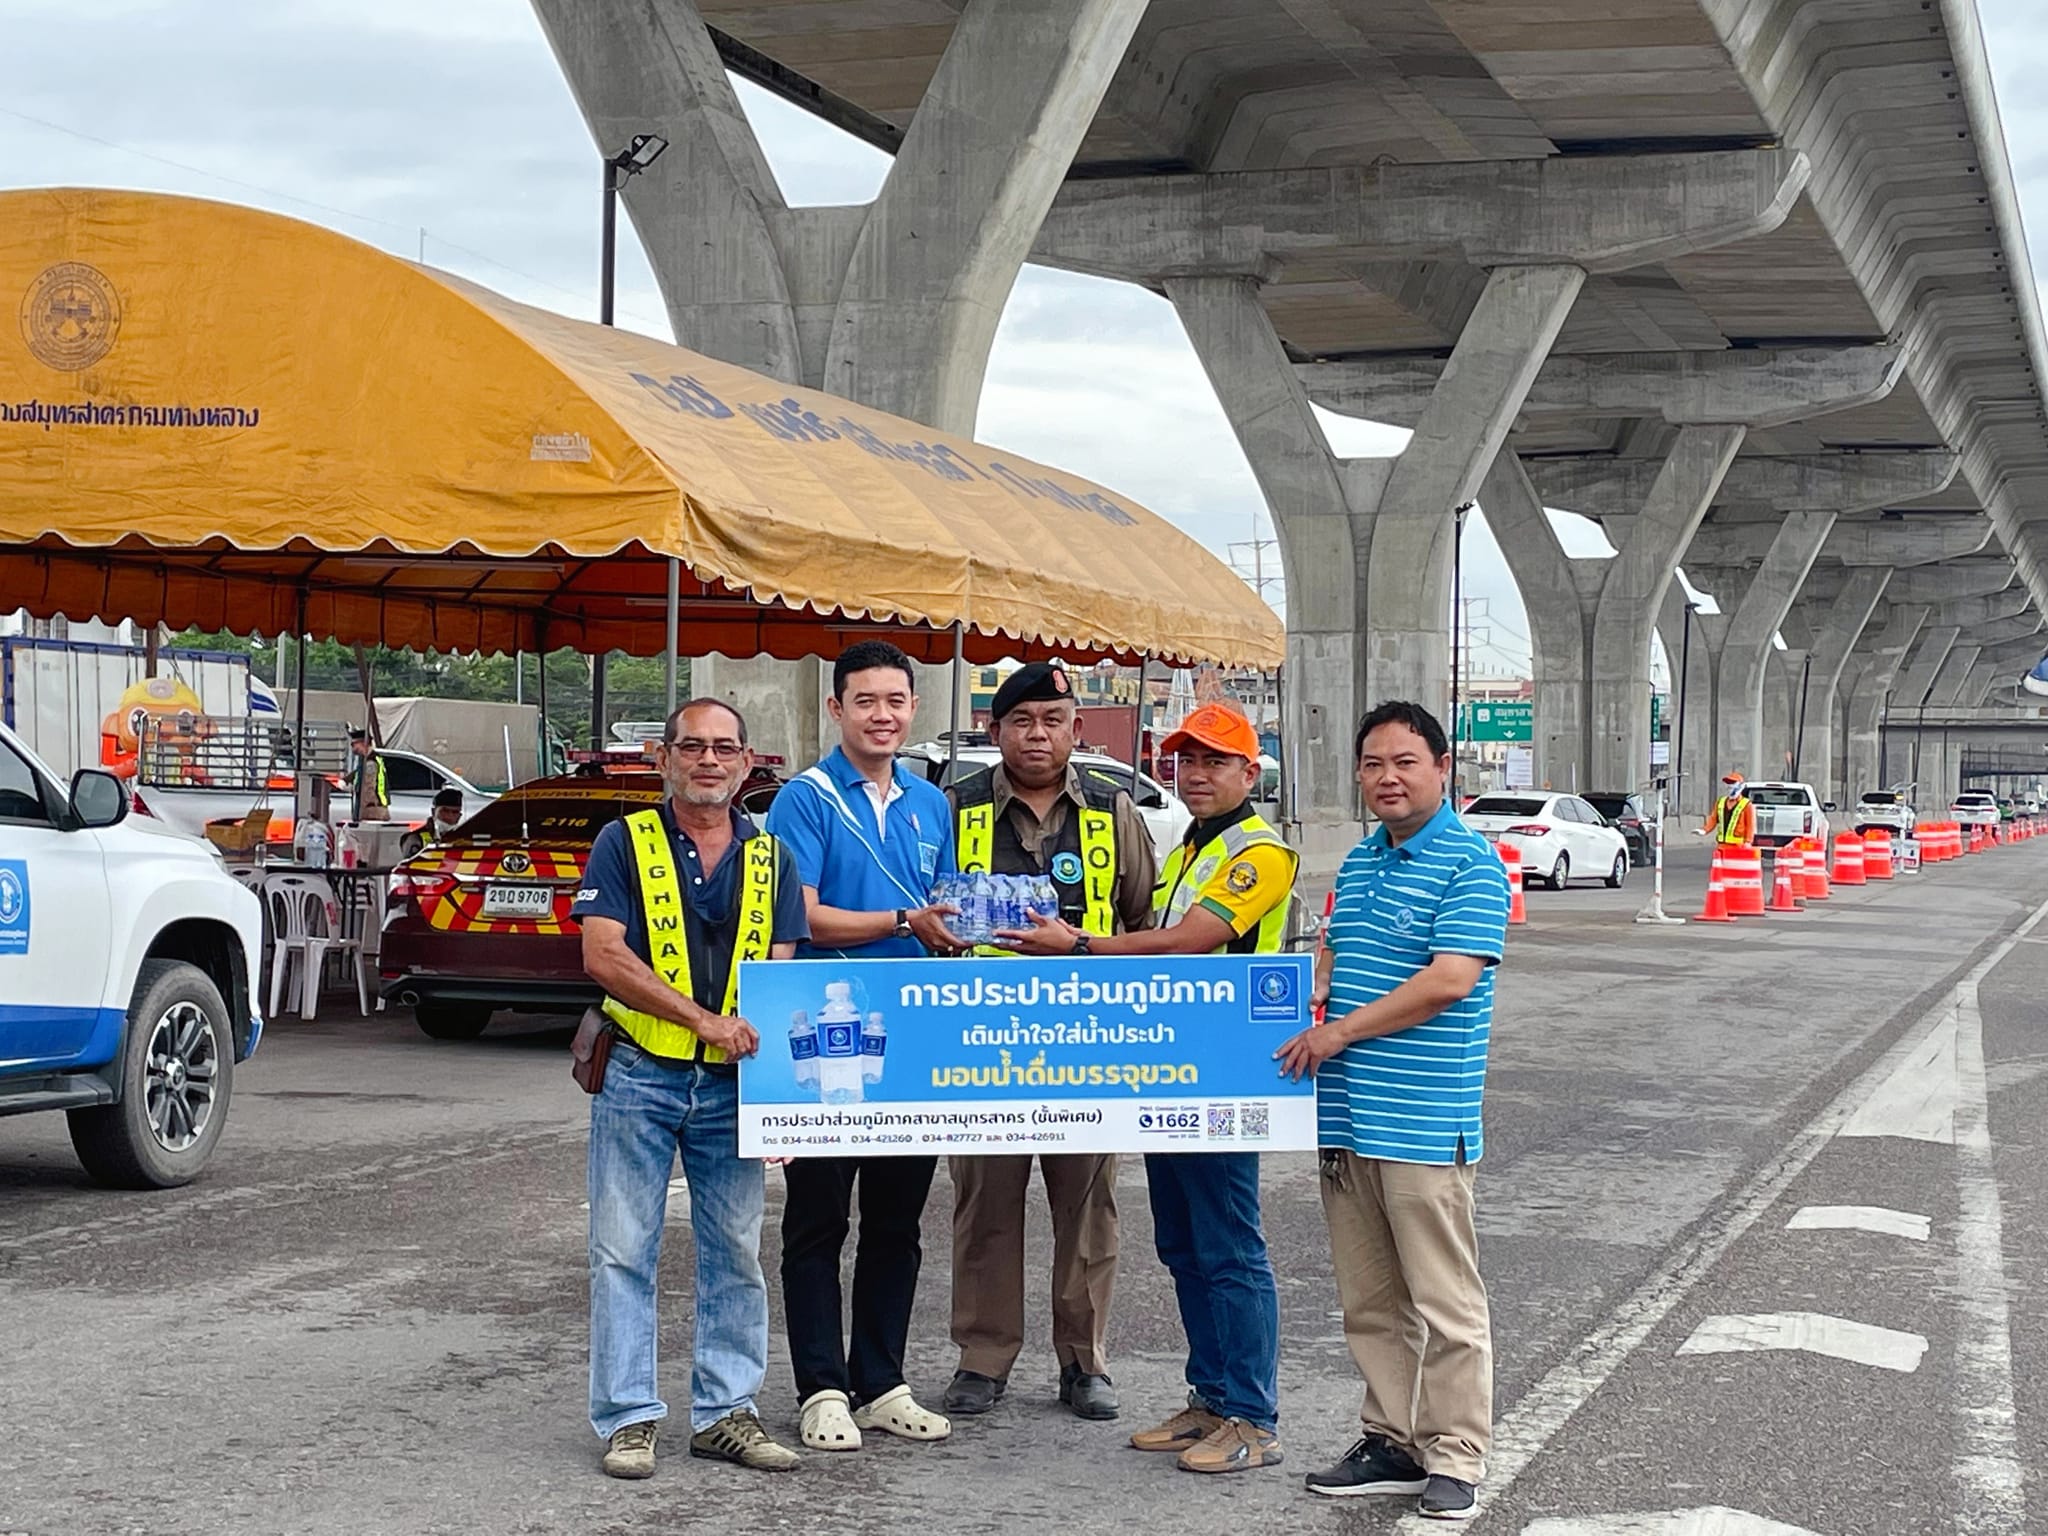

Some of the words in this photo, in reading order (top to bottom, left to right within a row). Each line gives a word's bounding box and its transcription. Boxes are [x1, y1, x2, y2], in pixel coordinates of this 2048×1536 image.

[540, 817, 590, 828] 2116
[517, 889, 549, 905] 9706
[638, 823, 679, 984] HIGHWAY
[899, 972, 1236, 1015] การประปาส่วนภูมิภาค
[961, 1015, 1176, 1046] เติมน้ำใจใส่น้ำประปา
[930, 1049, 1200, 1093] มอบน้ำดื่มบรรจุขวด
[761, 1110, 1026, 1131] การประปาส่วนภูมิภาคสาขาสมุทรสาคร
[1031, 1105, 1103, 1126] (ชั้นพิเศษ)
[1156, 1113, 1200, 1128] 1662
